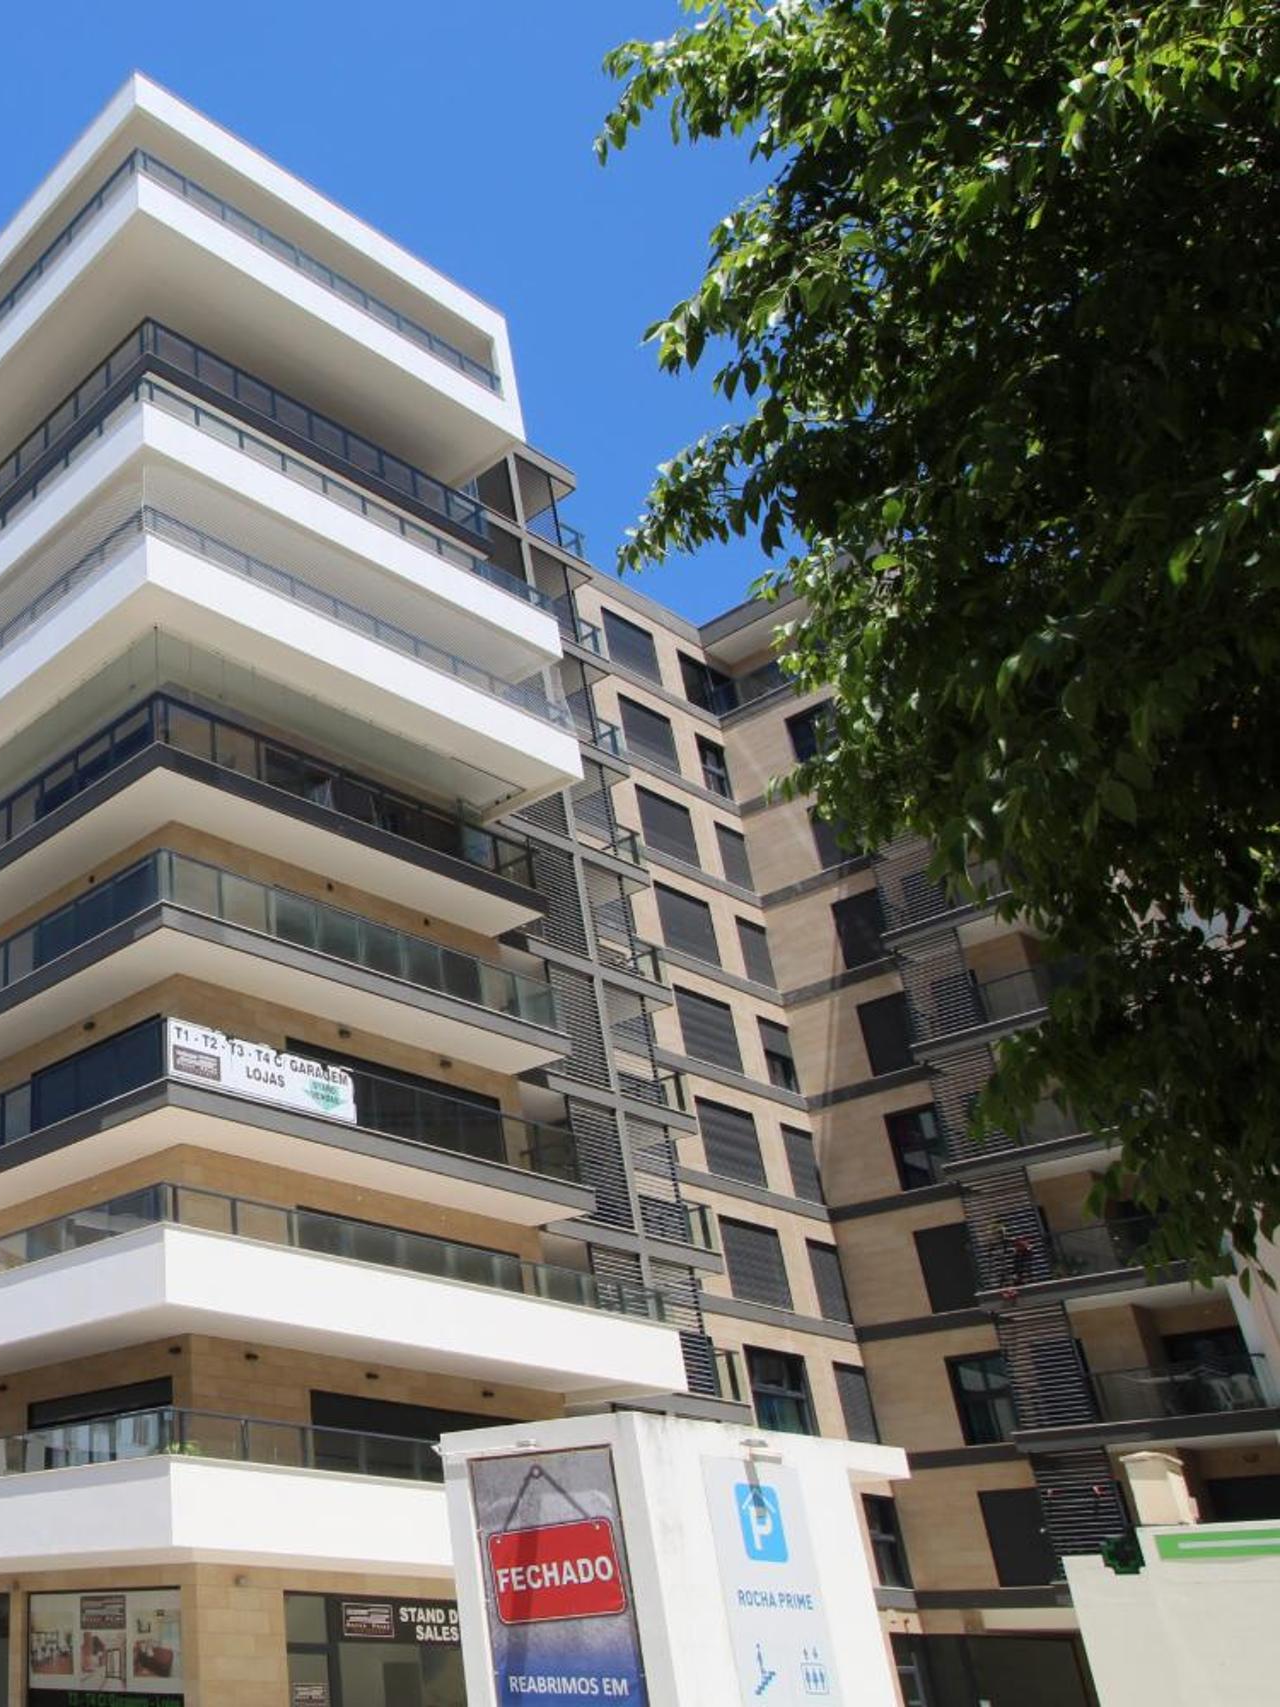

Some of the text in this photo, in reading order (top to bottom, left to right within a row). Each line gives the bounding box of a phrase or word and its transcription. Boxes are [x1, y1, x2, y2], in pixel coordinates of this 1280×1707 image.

[175, 1026, 189, 1041] T1
[202, 1034, 217, 1049] T2
[229, 1043, 244, 1057] T3
[255, 1049, 270, 1064] T4
[246, 1066, 285, 1088] LOJAS
[496, 1555, 613, 1593] FECHADO
[738, 1589, 814, 1610] ROCHA PRIME
[399, 1607, 459, 1625] STAND D
[415, 1624, 460, 1641] SALES
[509, 1675, 629, 1696] REABRIMOS EM
